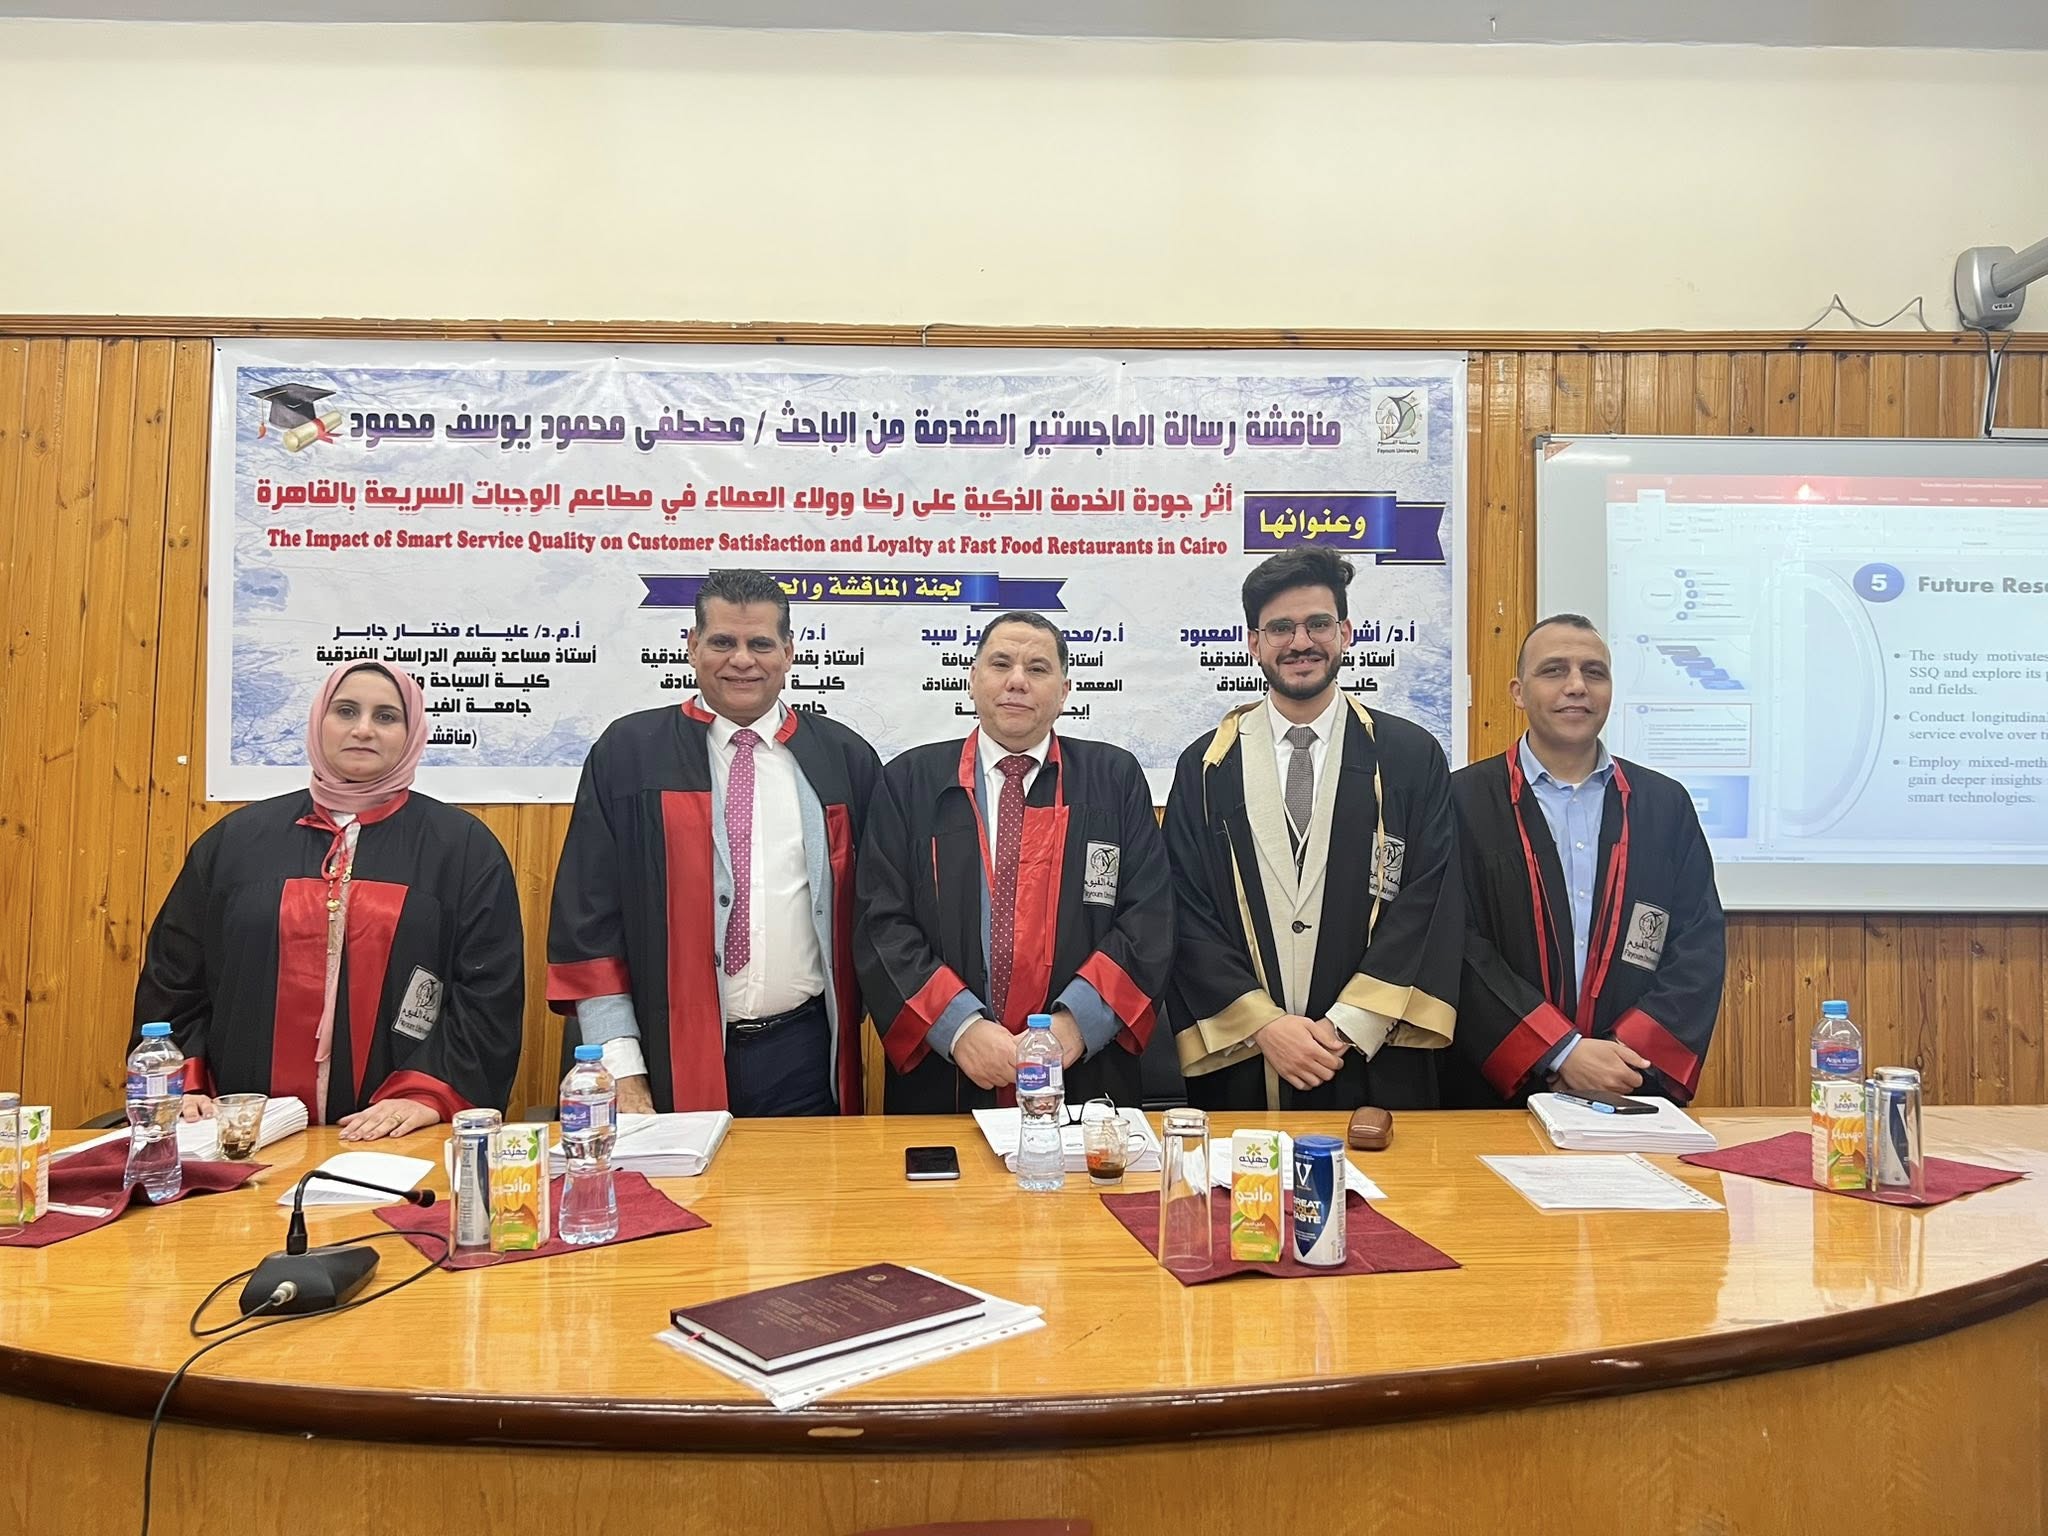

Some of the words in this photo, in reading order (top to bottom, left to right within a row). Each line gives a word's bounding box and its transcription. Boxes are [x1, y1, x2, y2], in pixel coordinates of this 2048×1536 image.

[350, 413, 434, 448] محمود
[446, 404, 531, 450] يوسف
[541, 415, 625, 449] محمود
[635, 406, 745, 451] مصطفى
[754, 410, 766, 446] /
[776, 400, 856, 452] الباحث
[866, 412, 905, 454] من
[915, 409, 1015, 445] المقدمة
[1024, 411, 1154, 456] الماجستير
[1164, 411, 1235, 456] رسالة
[1246, 404, 1341, 445] مناقشة
[257, 479, 356, 510] بالقاهرة
[365, 480, 463, 511] السريعة
[472, 481, 560, 513] الوجبات
[568, 484, 653, 513] مطاعم
[661, 483, 696, 521] في
[705, 486, 785, 508] العملاء
[793, 487, 854, 516] وولاء
[863, 487, 904, 517] رضا
[913, 488, 956, 517] على
[965, 486, 1043, 518] الذكية
[1050, 487, 1125, 511] الخدمة
[1133, 487, 1193, 518] جودة
[1200, 482, 1233, 518] أثر
[1260, 507, 1366, 539] وعنوانها
[267, 529, 300, 547] The
[306, 529, 369, 551] Impact
[374, 530, 392, 548] of
[396, 530, 452, 548] Smart
[457, 530, 523, 549] Service
[528, 530, 596, 553] Quality
[600, 536, 623, 550] on
[628, 532, 714, 550] Customer
[719, 533, 826, 552] Satisfaction
[830, 535, 863, 553] and
[867, 535, 933, 557] Loyalty
[938, 537, 955, 553] at
[960, 536, 997, 554] Fast
[1001, 536, 1043, 554] Food
[1047, 537, 1153, 555] Restaurants
[1158, 537, 1176, 555] in
[1180, 537, 1227, 555] Cairo
[828, 574, 907, 597] المناقشة
[914, 576, 962, 602] لجنة
[1871, 574, 1888, 591] 5
[1919, 576, 1994, 593] Future
[333, 623, 388, 641] جابر
[393, 622, 460, 640] مختار
[466, 624, 529, 641] علياء
[921, 628, 957, 645] سيد
[1180, 625, 1243, 648] المعبود
[383, 647, 448, 666] الدراسات
[453, 646, 496, 667] بقسم
[502, 649, 550, 663] مساعد
[556, 645, 597, 664] أستاذ
[824, 647, 864, 665] أستاذ
[1069, 651, 1103, 666] أستاذ
[1359, 649, 1395, 666] أستاذ
[1909, 650, 1935, 661] The
[1943, 650, 1978, 664] study
[431, 672, 489, 692] السياحة
[495, 672, 550, 691] كلية
[791, 673, 845, 694] كلية
[1909, 667, 1939, 680] SSQ
[1944, 667, 1967, 678] and
[1972, 668, 2021, 681] explore
[2026, 668, 2041, 678] its
[1076, 679, 1123, 692] المعهد
[1909, 684, 1933, 695] and
[1938, 683, 1978, 695] fields.
[466, 698, 531, 716] جامعة
[1909, 711, 1965, 722] Conduct
[1909, 728, 1955, 740] service
[1960, 729, 2003, 740] evolve
[2007, 732, 2036, 740] over
[1909, 756, 1960, 770] Employ
[1908, 774, 1936, 788] gain
[1941, 774, 1986, 788] deeper
[1991, 774, 2042, 788] insights
[1908, 793, 1945, 803] smart
[1949, 792, 2036, 806] technologies.
[1832, 1130, 1863, 1143] Mango
[1295, 1162, 1312, 1186] V
[1235, 1184, 1272, 1203] مانجو
